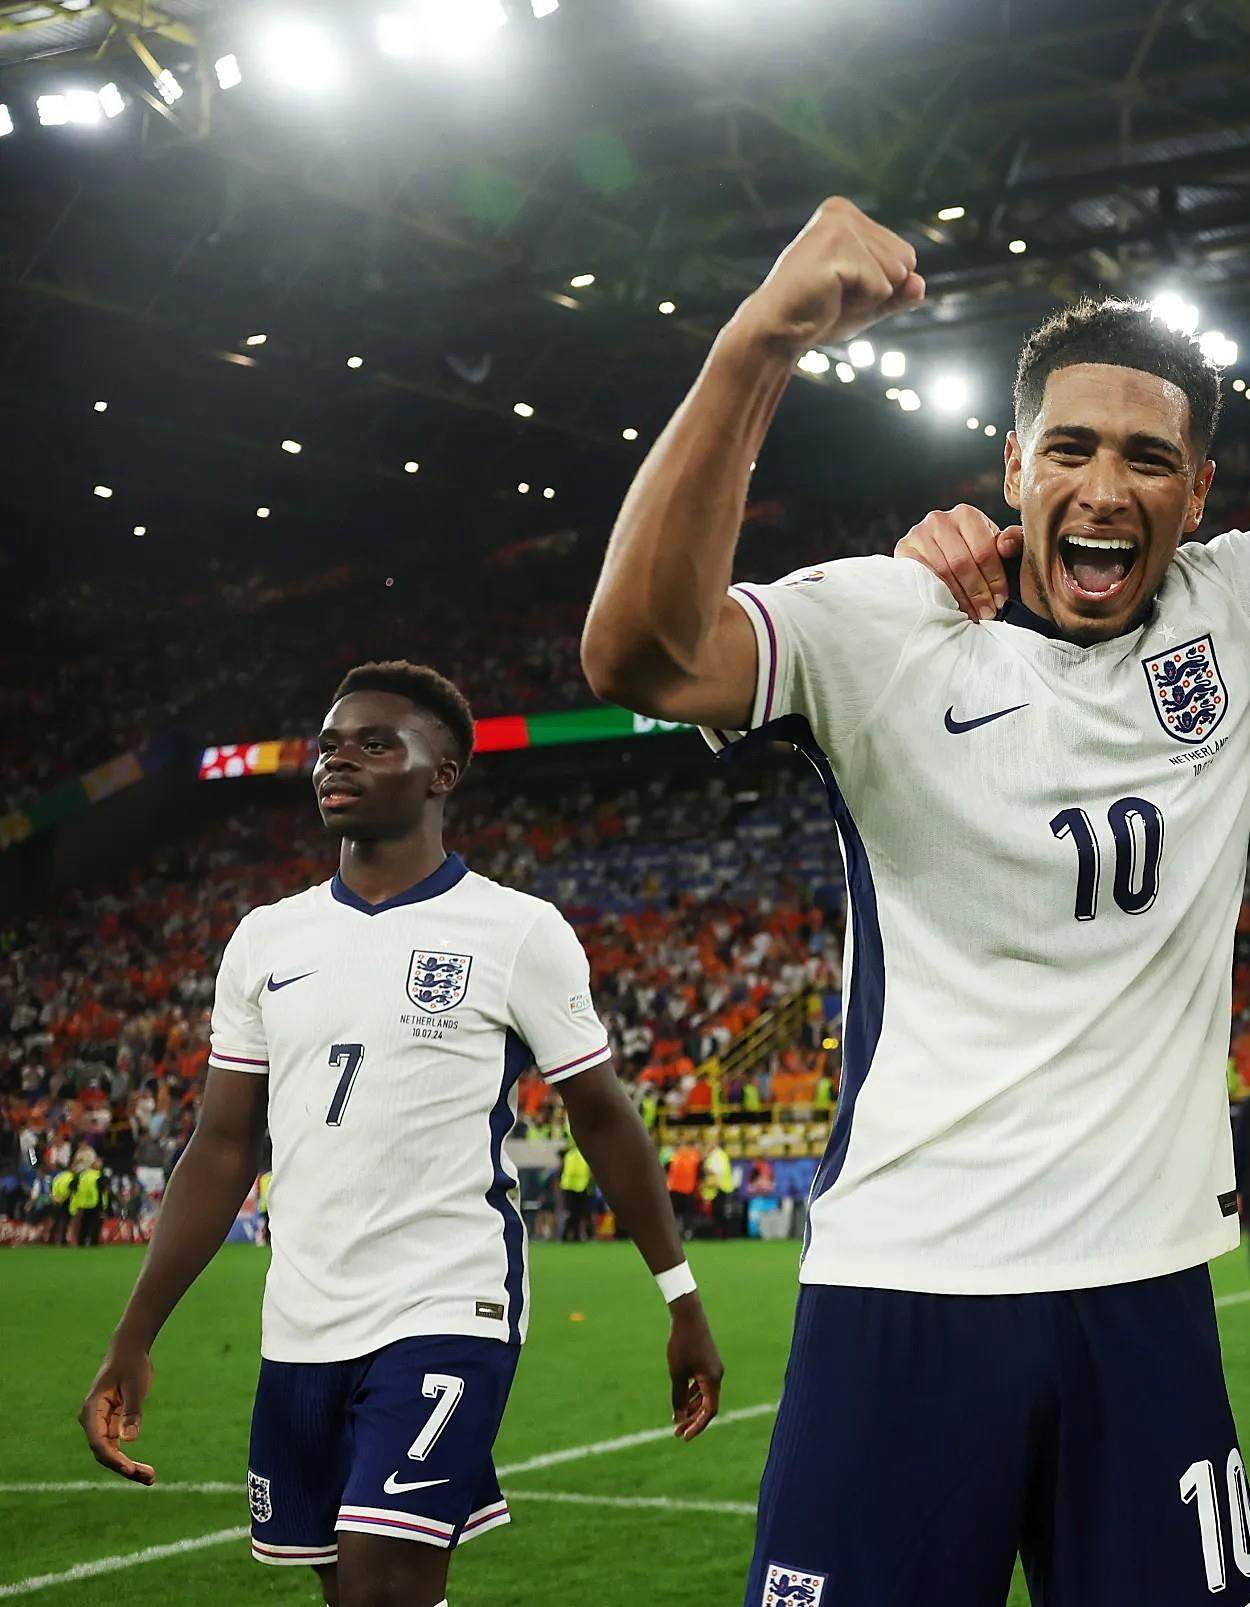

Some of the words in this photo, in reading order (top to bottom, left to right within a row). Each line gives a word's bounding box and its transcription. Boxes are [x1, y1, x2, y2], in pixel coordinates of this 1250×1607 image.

[1168, 736, 1229, 765] NETHERLAN
[1049, 797, 1164, 921] 10
[400, 1014, 459, 1030] NETHERLANDS
[412, 1027, 444, 1040] 10.07.24
[326, 1044, 365, 1126] 7
[407, 1374, 464, 1461] 7
